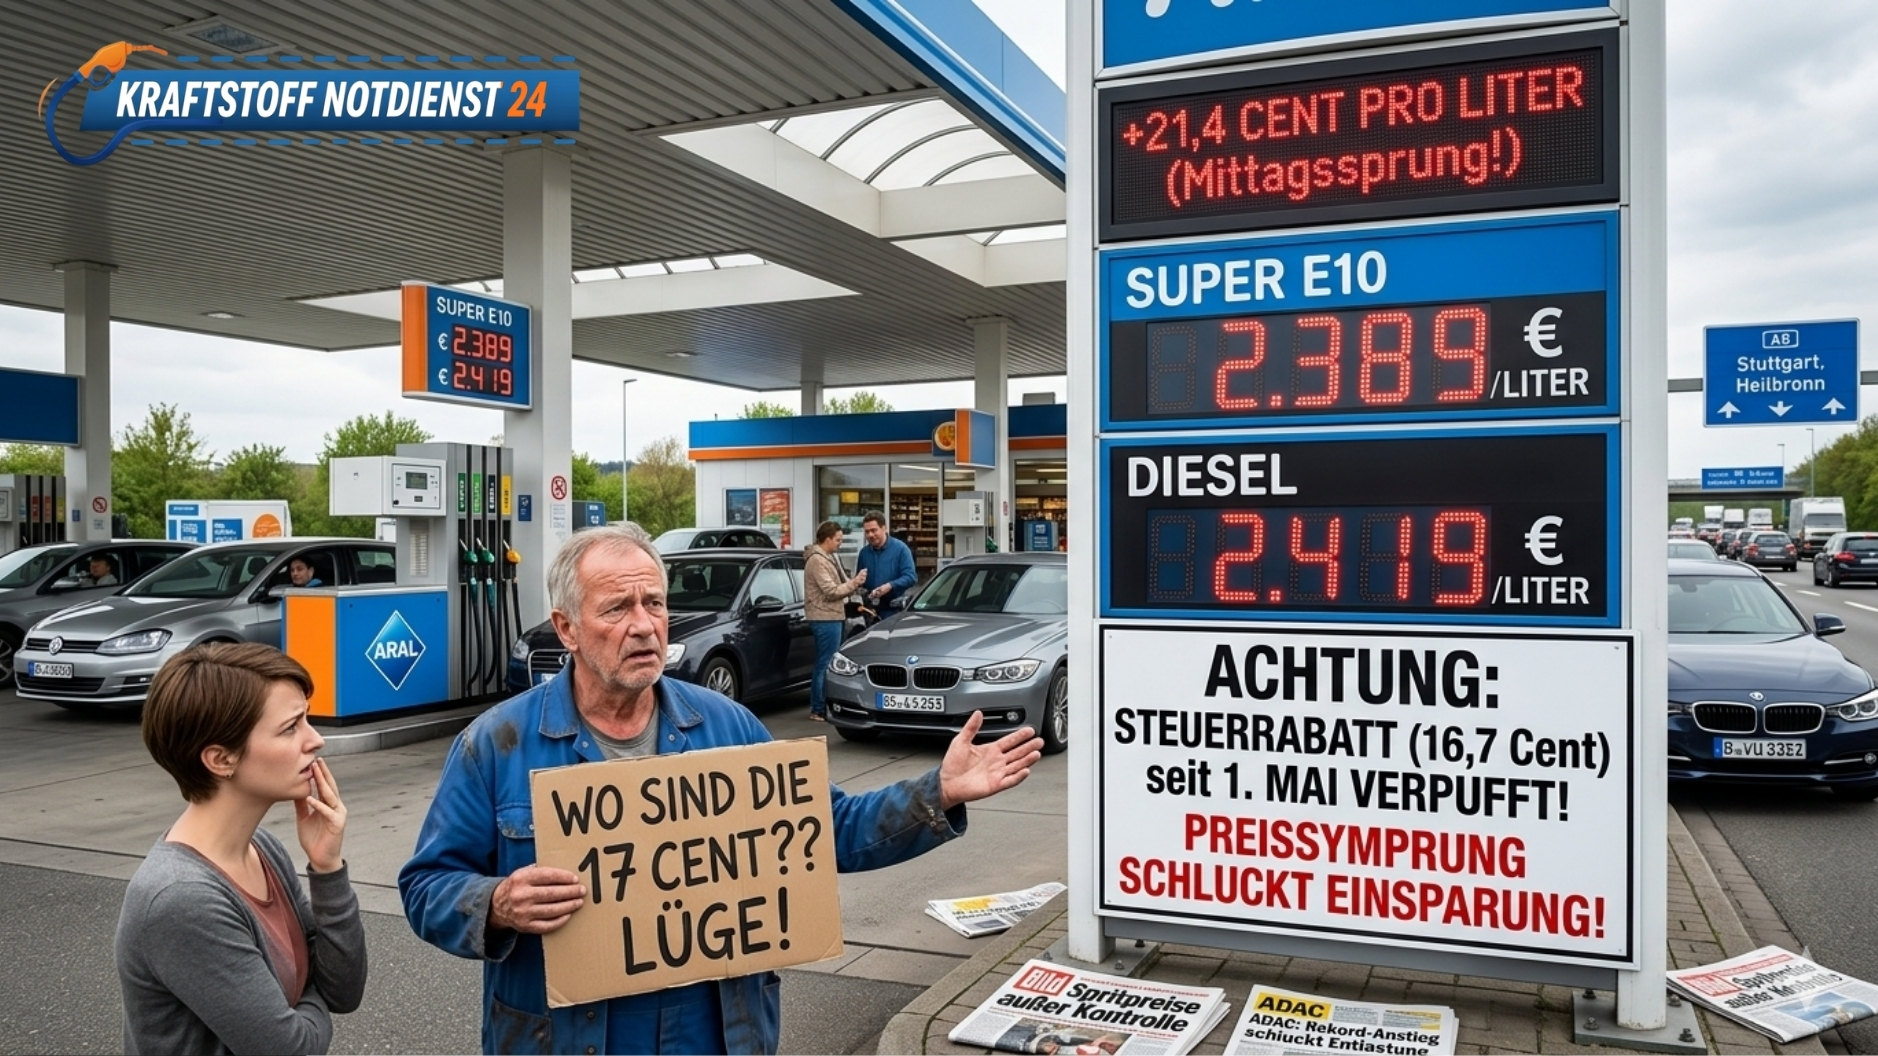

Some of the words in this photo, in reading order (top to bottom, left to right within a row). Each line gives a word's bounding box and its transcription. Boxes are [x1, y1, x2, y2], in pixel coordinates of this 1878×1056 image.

[1122, 104, 1227, 153] +21,4
[1239, 91, 1346, 141] CENT
[1359, 82, 1444, 129] PRO
[1459, 65, 1584, 118] LITER
[1166, 127, 1522, 208] (Mittagssprung!)
[1125, 258, 1285, 308] SUPER
[1303, 250, 1387, 297] E10
[436, 296, 484, 322] SUPER
[489, 307, 512, 327] E10
[438, 333, 448, 350] €
[453, 326, 512, 363] 2.389
[1215, 308, 1486, 409] 2.389
[1524, 307, 1564, 358] €
[1737, 354, 1825, 373] Stuttgart,
[438, 368, 448, 385] €
[453, 362, 512, 395] 2.419
[1490, 367, 1589, 399] /LITER
[1736, 377, 1825, 393] Heilbronn
[1127, 453, 1298, 497] DIESEL
[1215, 512, 1486, 604] 2.419
[1524, 515, 1564, 566] €
[1491, 575, 1589, 605] /LITER
[374, 640, 418, 660] ARAL
[1204, 644, 1500, 709] ACHTUNG:
[1114, 707, 1398, 759] STEUERRABATT
[1408, 723, 1498, 769] (16,7
[1510, 728, 1611, 778] Cent)
[551, 784, 624, 836] WO
[640, 771, 735, 825] SIND
[748, 760, 813, 810] DIE
[1146, 758, 1211, 798] seit
[1224, 762, 1253, 800] 1.
[1266, 763, 1338, 807] MAI
[1350, 769, 1570, 822] VERPUFFT!
[578, 842, 636, 904] 17
[651, 816, 822, 891] CENT??
[1184, 813, 1526, 878] PREISSYMPRUNG
[1119, 856, 1314, 911] SCHLUCKT
[1326, 874, 1606, 939] EINSPARUNG!
[622, 887, 791, 976] LÜGE!
[997, 993, 1071, 1016] außer
[1072, 1003, 1189, 1032] Kontrolle
[1066, 982, 1201, 1014] Spritpreise
[1257, 997, 1325, 1018] ADAC
[1248, 1013, 1301, 1030] ADAC:
[1305, 1021, 1440, 1046] Rekord-Anstieg
